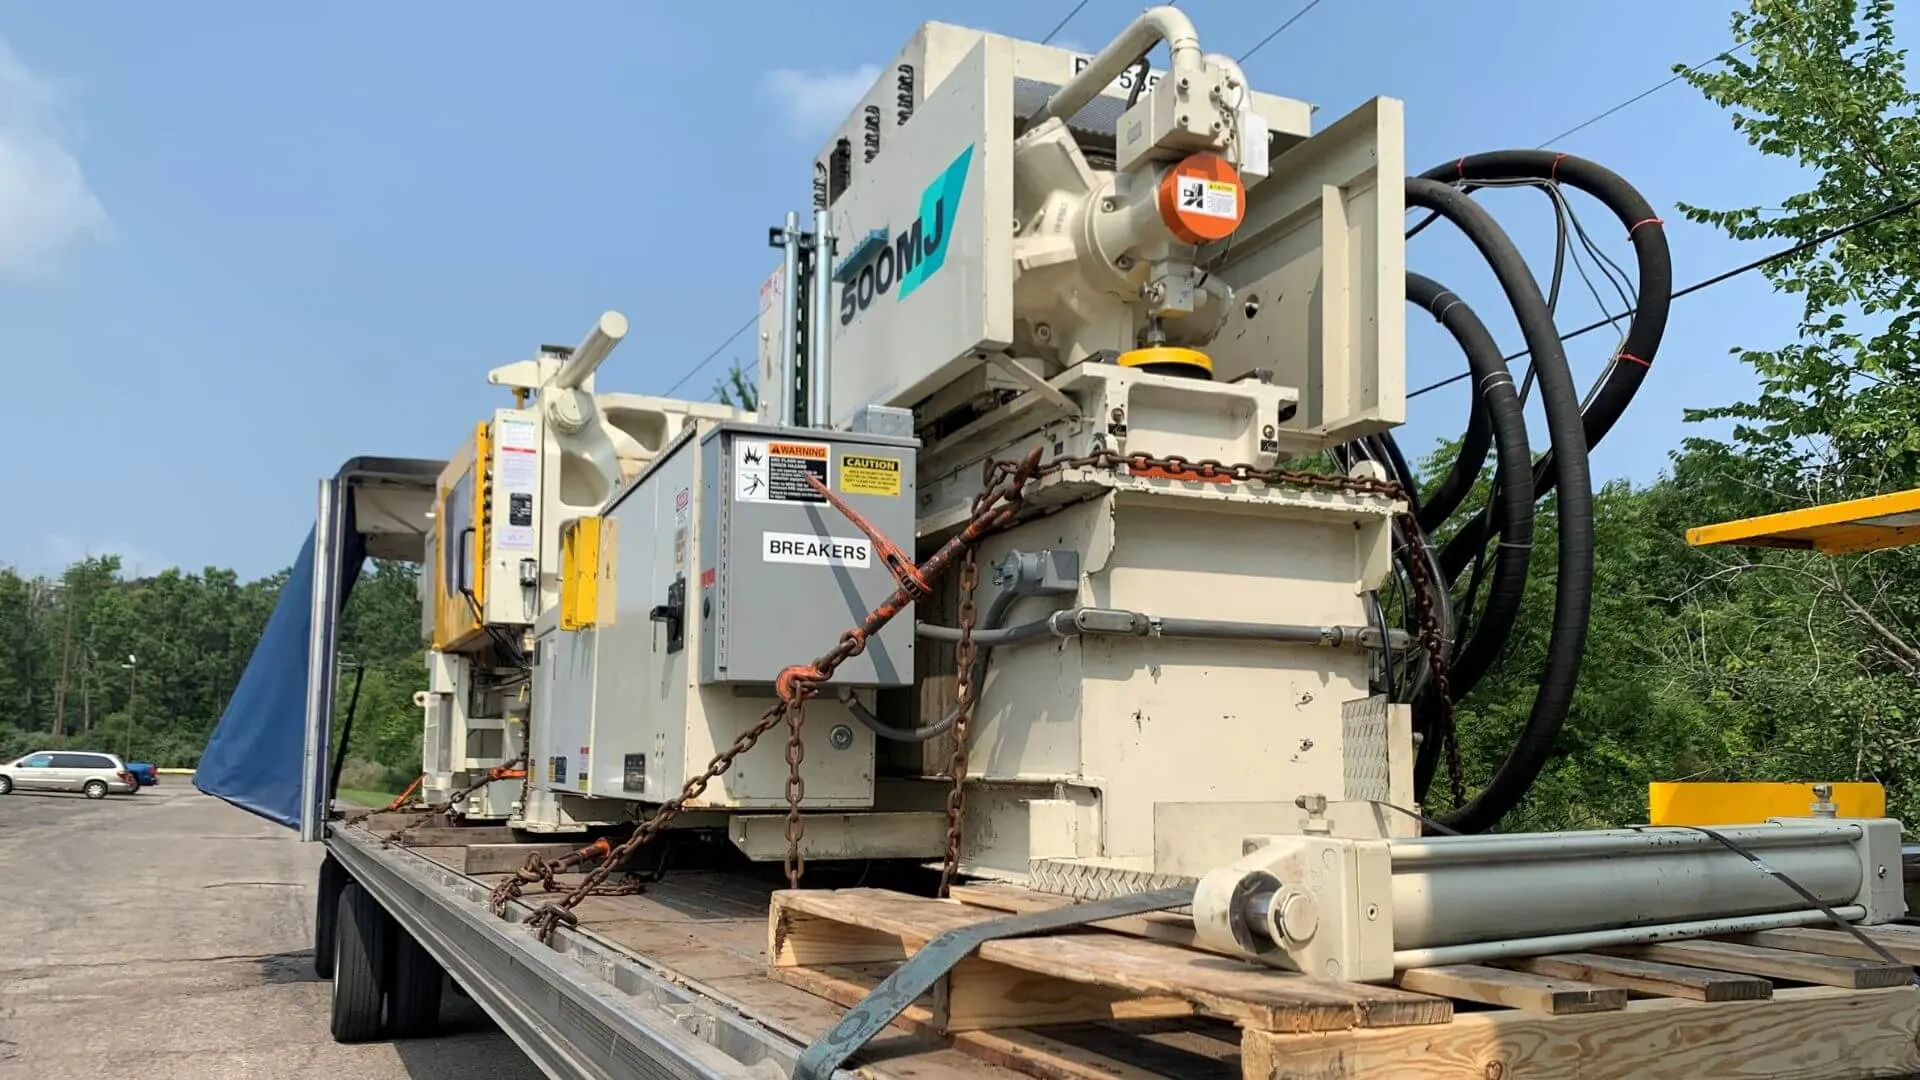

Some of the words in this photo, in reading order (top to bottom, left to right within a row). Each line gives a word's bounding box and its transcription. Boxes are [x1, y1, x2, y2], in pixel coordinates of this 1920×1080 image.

[841, 197, 944, 326] 500MJ
[780, 446, 825, 457] WARNING
[847, 458, 896, 470] CAUTION
[770, 540, 866, 560] BREAKERS
